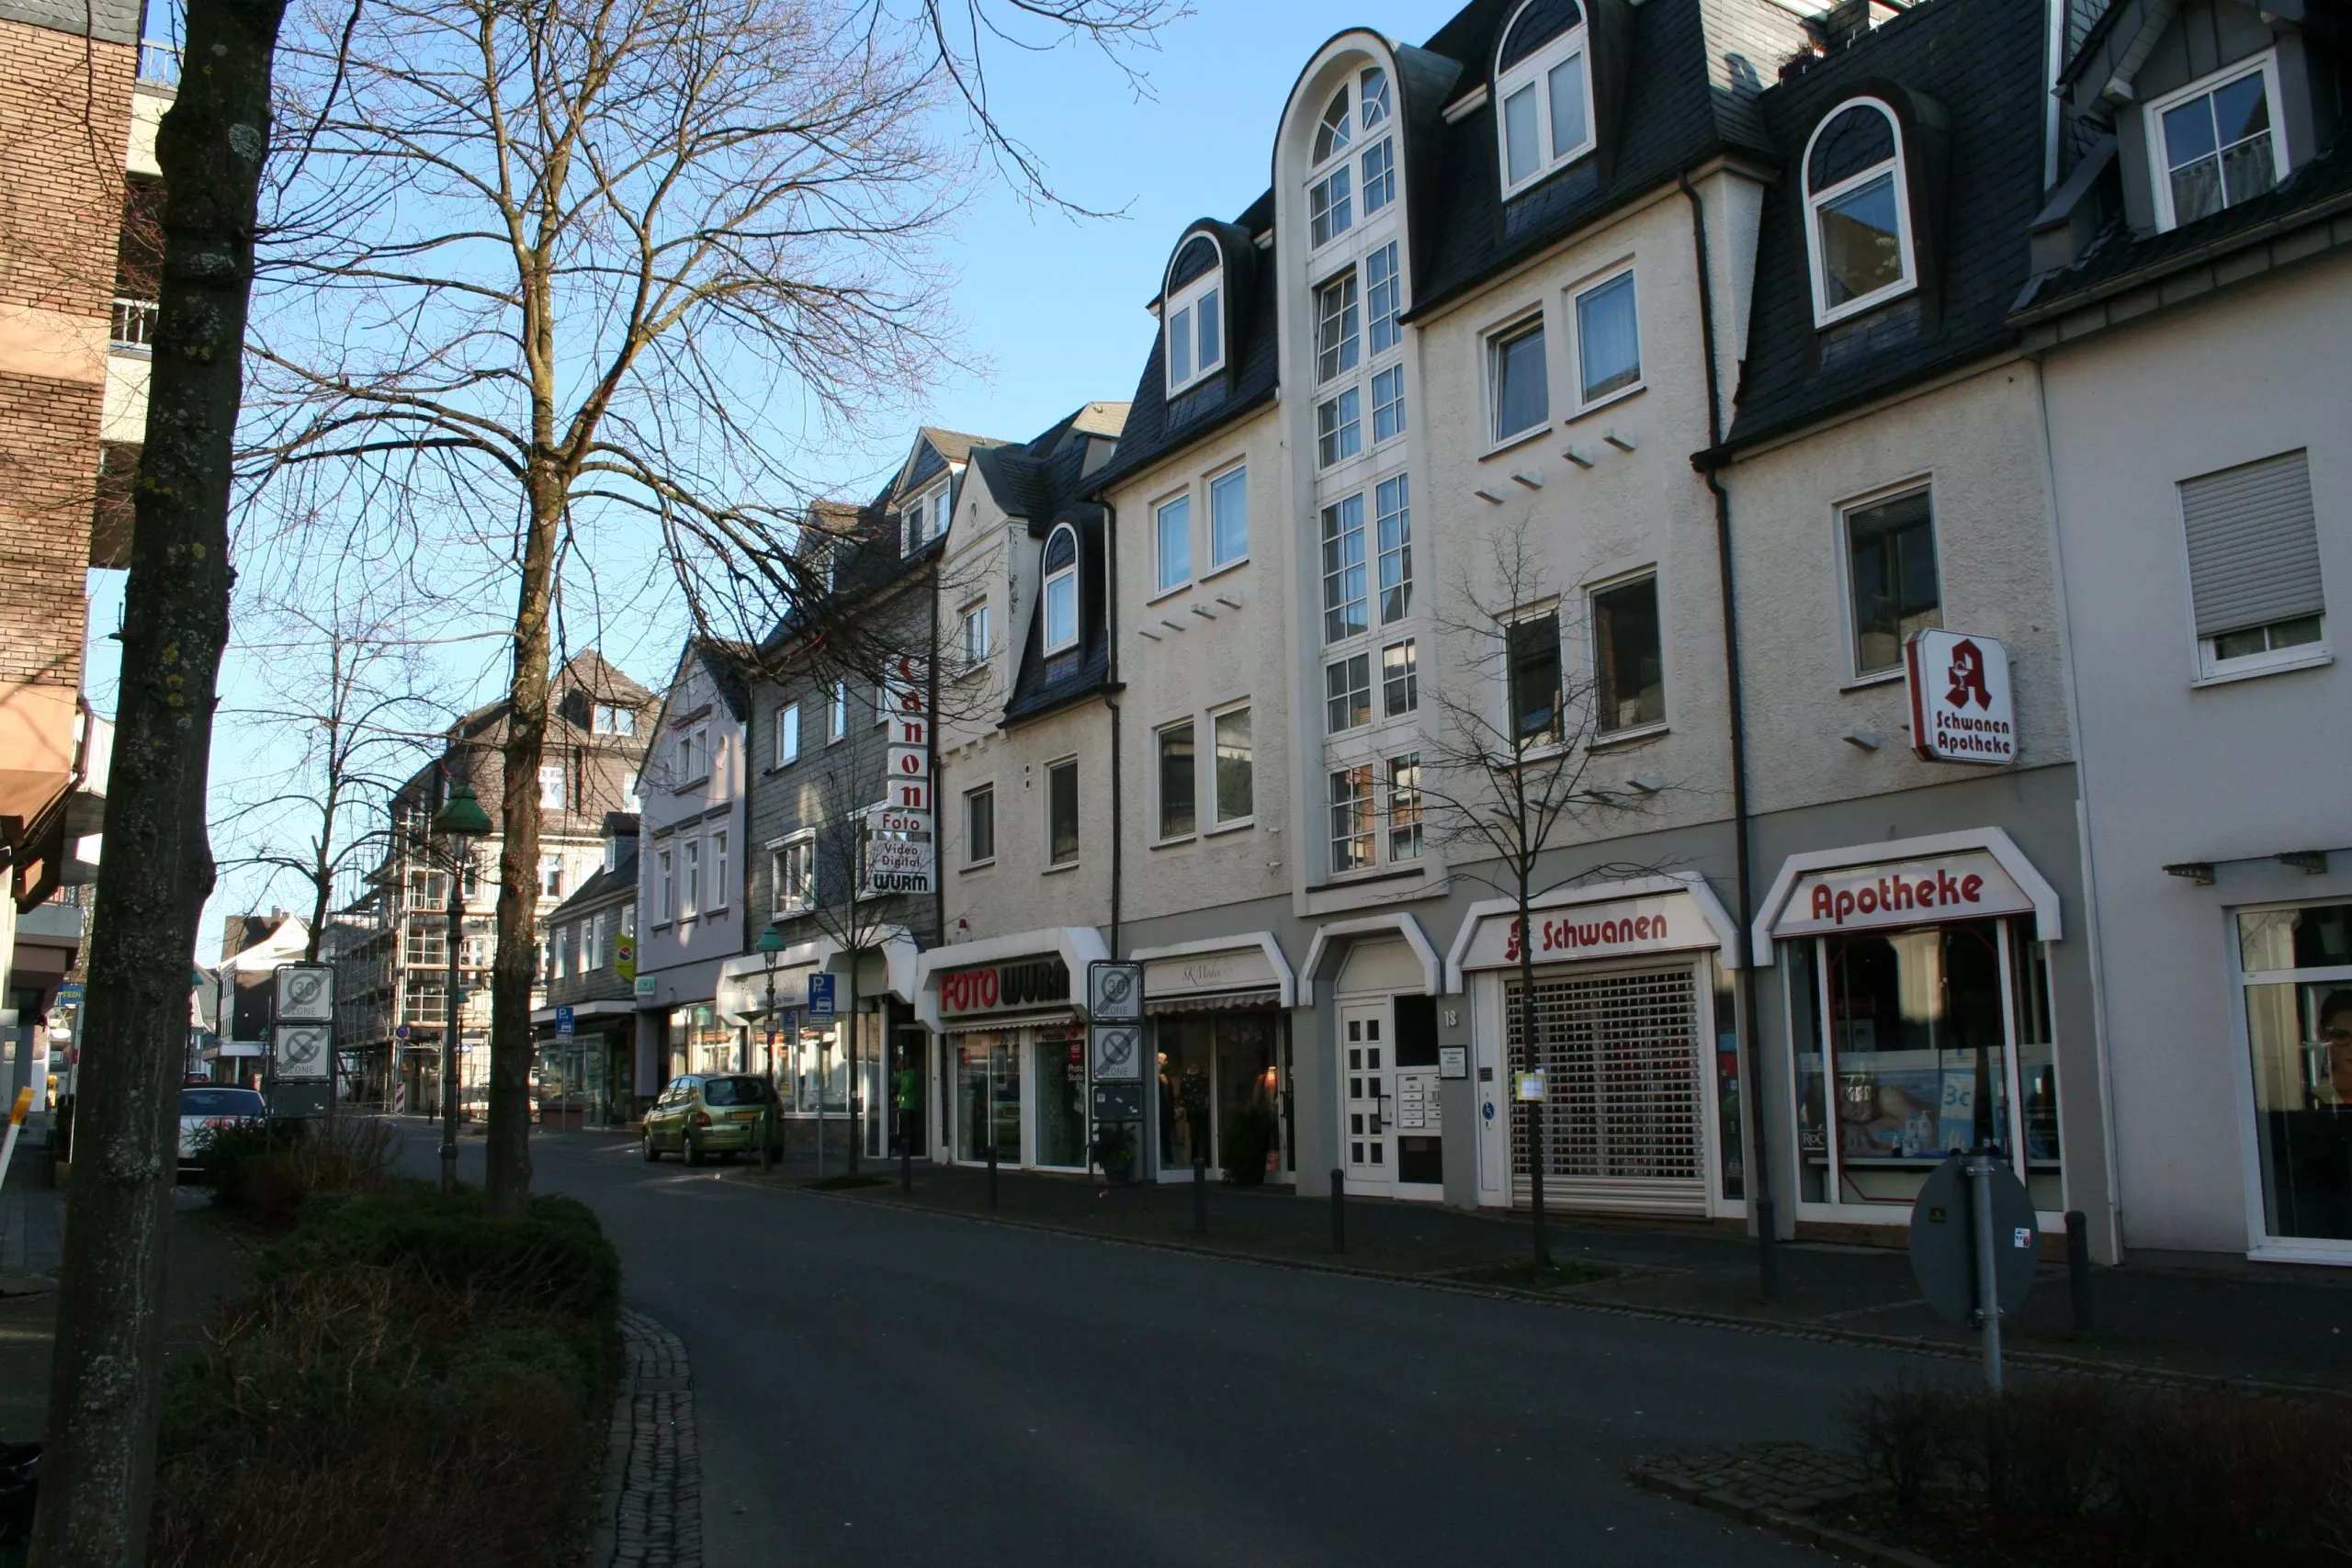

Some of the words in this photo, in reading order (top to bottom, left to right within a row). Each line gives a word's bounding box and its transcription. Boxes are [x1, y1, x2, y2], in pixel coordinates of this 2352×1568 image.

[899, 654, 923, 807] Canon
[1937, 710, 2009, 734] Schwanen
[1938, 731, 2010, 754] Apotheke
[883, 814, 920, 830] Foto
[885, 843, 918, 855] Video
[883, 855, 920, 868] Digital
[874, 874, 928, 891] WURM
[1812, 869, 1984, 924] Apotheke
[1543, 914, 1668, 951] Schwanen
[941, 968, 999, 1012] FOTO
[290, 1007, 317, 1016] ZONE
[1105, 1006, 1128, 1015] ZONE
[1444, 1010, 1457, 1028] 18
[289, 1066, 315, 1075] ZONE
[1105, 1067, 1129, 1077] ZONE
